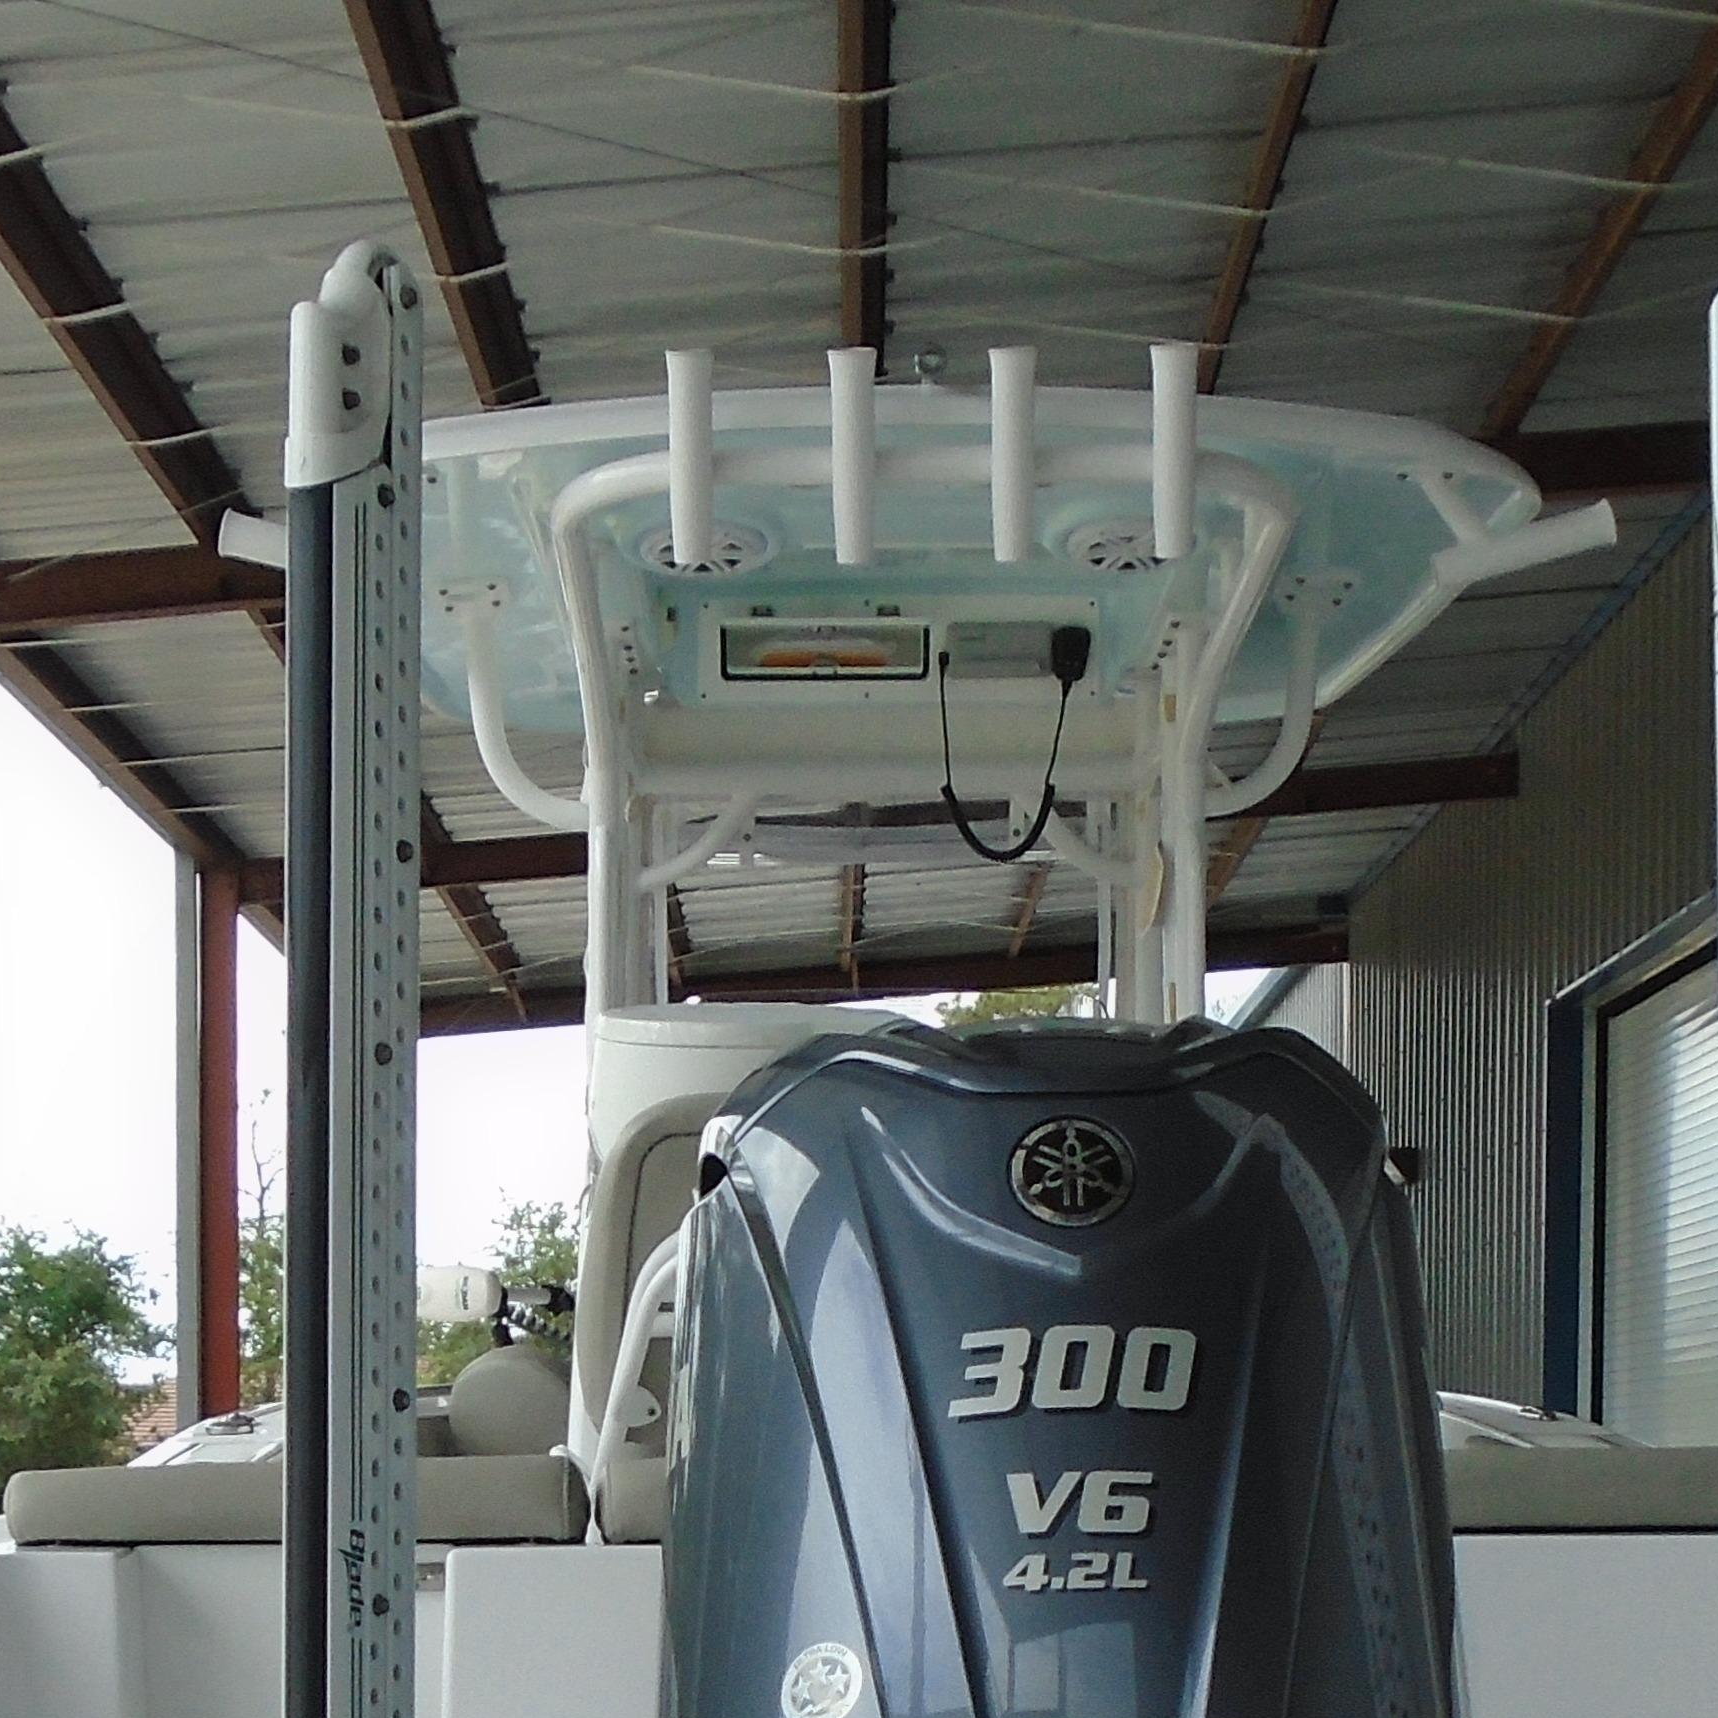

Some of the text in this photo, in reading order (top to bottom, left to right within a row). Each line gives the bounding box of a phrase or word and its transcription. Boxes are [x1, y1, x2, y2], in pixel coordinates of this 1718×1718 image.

[947, 1324, 1197, 1418] 300
[1005, 1470, 1154, 1534] V6
[1002, 1551, 1149, 1592] 4.2L
